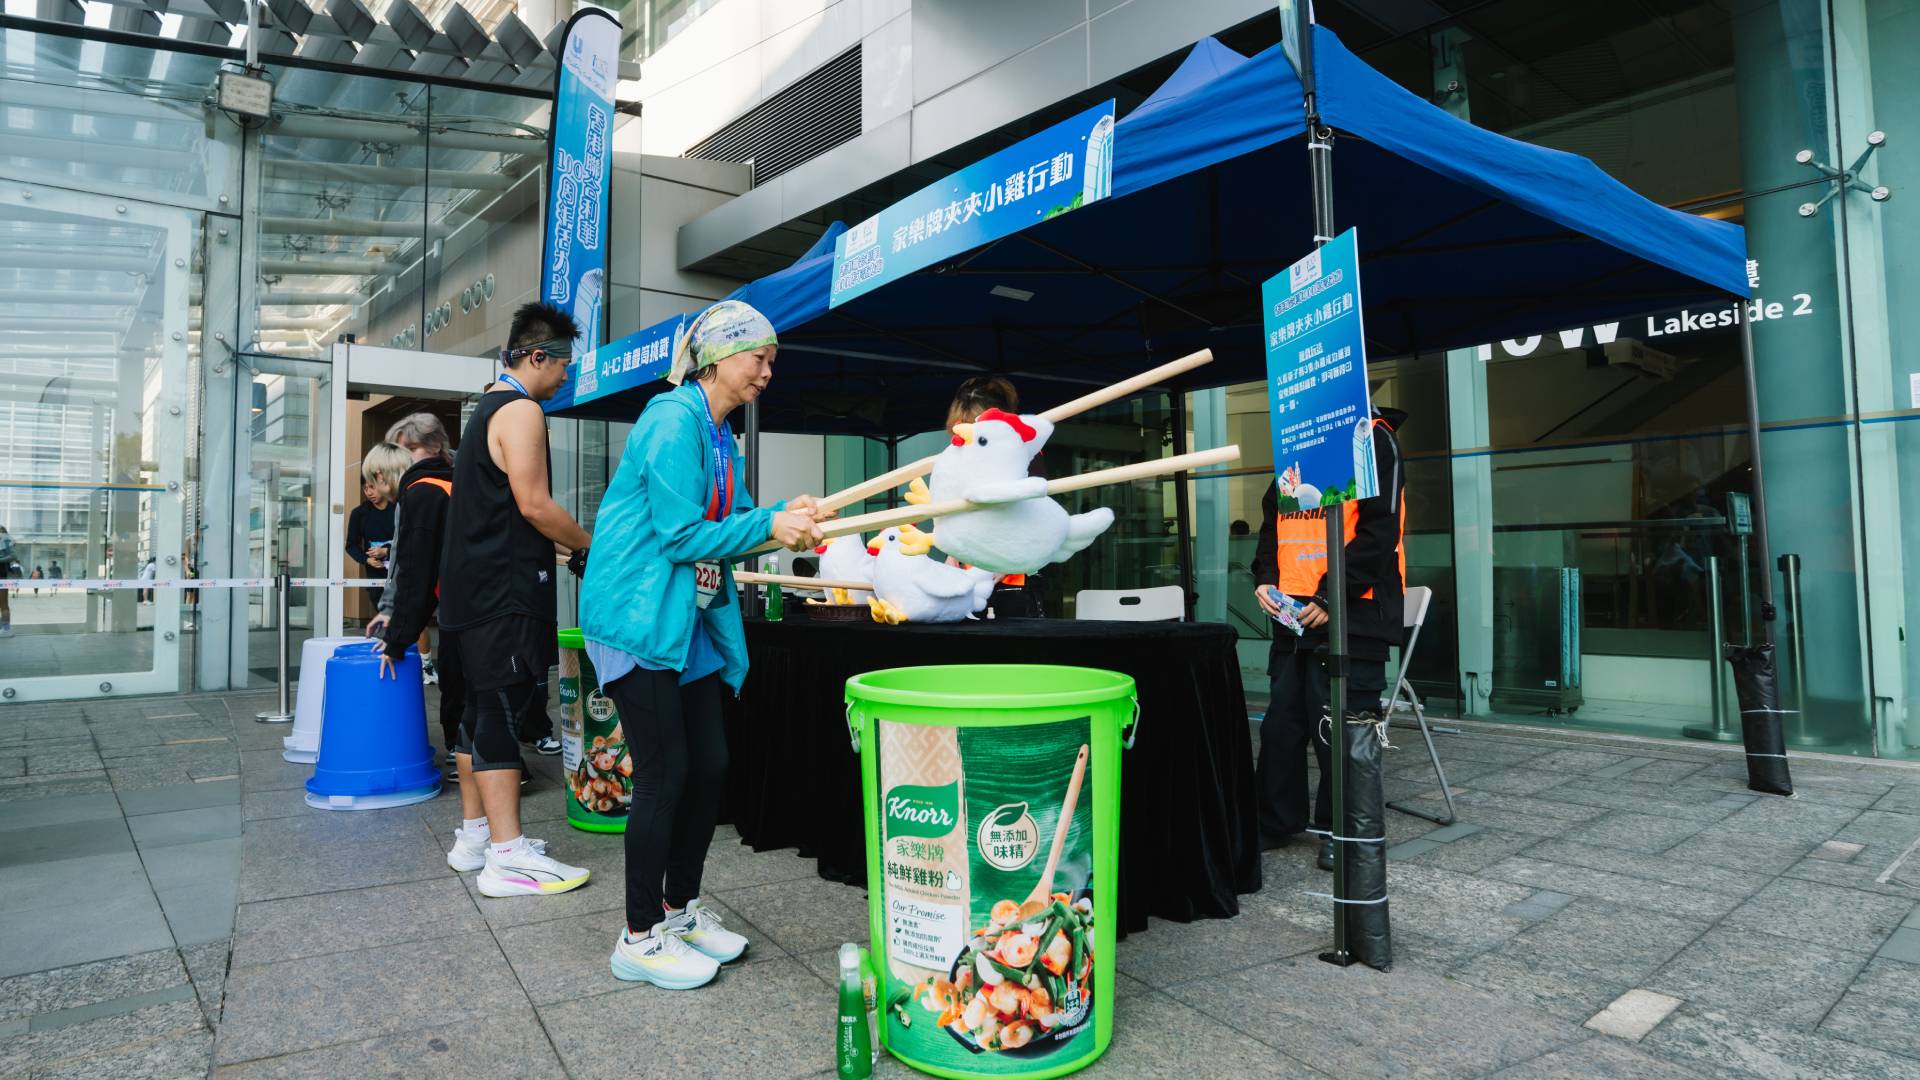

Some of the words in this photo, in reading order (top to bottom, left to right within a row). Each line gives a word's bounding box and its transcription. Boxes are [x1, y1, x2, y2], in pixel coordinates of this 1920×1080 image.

[578, 104, 606, 249] 香港聯合利華
[892, 151, 1074, 254] 家樂牌夾夾小雞行動
[1647, 299, 1784, 337] Lakeside
[1792, 293, 1814, 316] 2
[887, 796, 953, 826] Knorr
[990, 829, 1028, 843] 無添加
[896, 839, 945, 863] 家樂牌
[887, 860, 944, 889] 純鮮雞粉
[893, 899, 907, 912] Our
[908, 904, 945, 920] Promise
